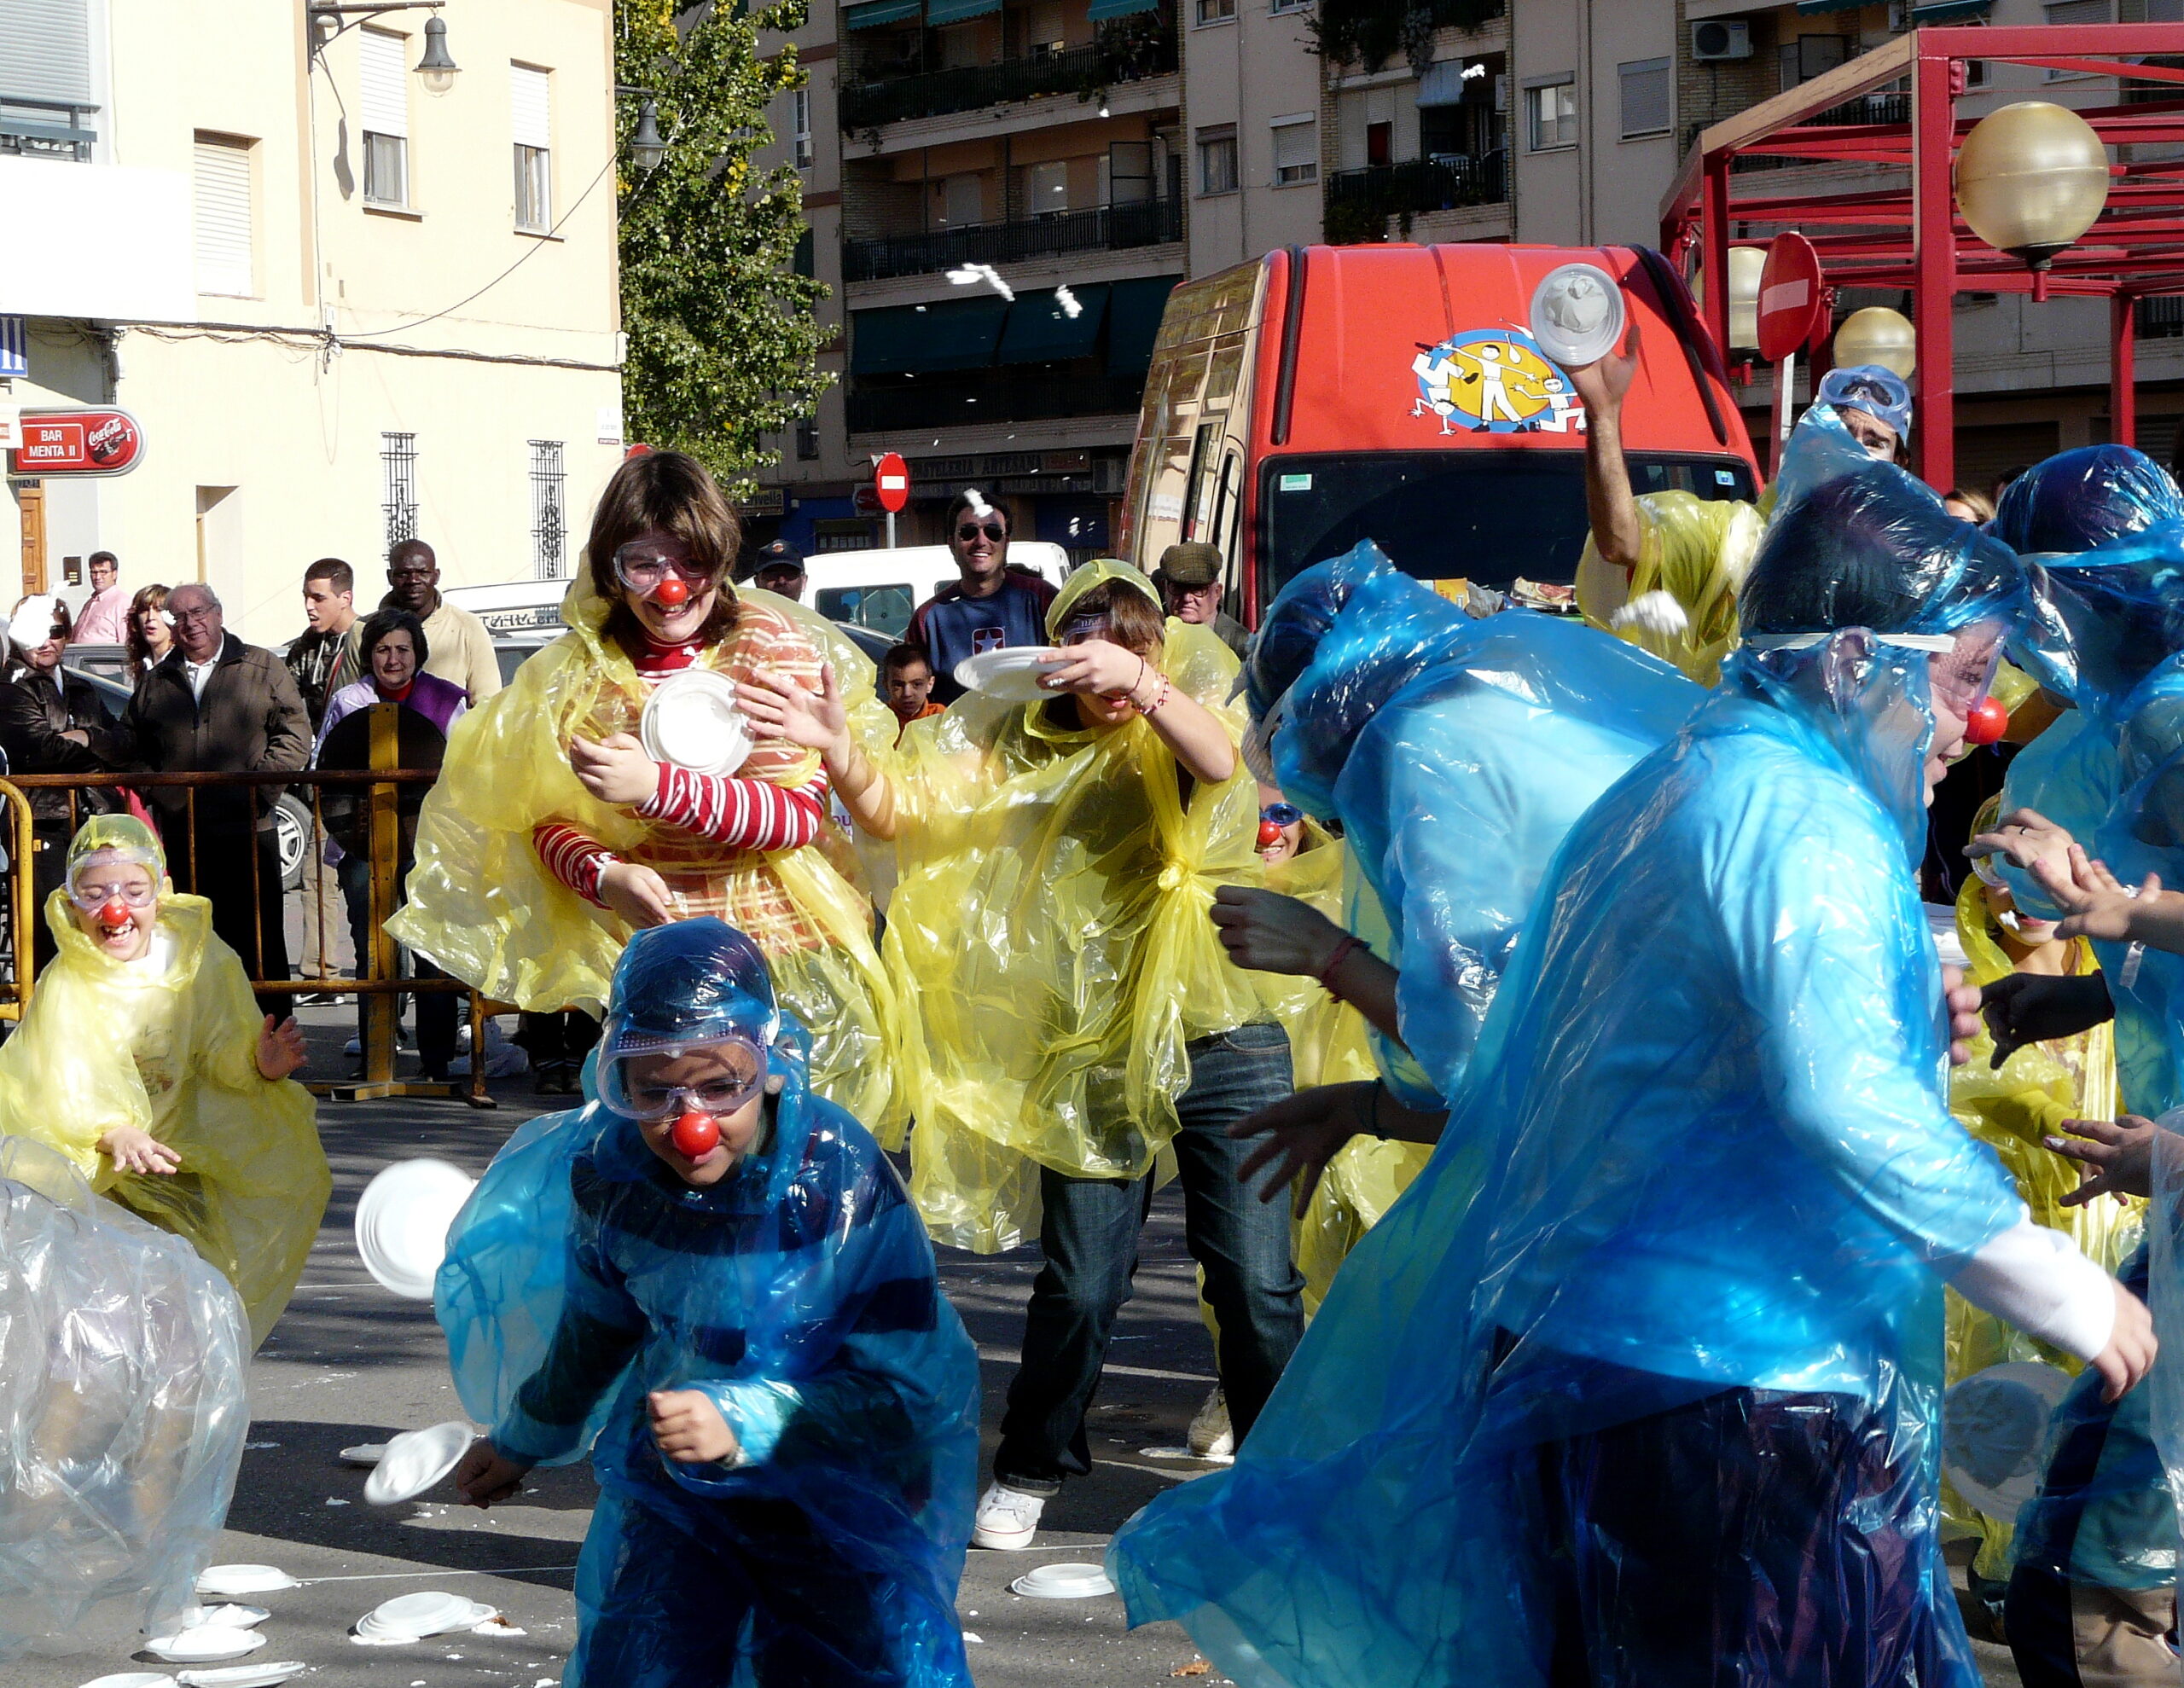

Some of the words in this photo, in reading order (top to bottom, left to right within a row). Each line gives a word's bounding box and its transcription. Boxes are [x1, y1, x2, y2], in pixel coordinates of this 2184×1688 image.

[41, 430, 62, 442] BAR
[29, 445, 64, 457] MENTA
[69, 445, 76, 456] II
